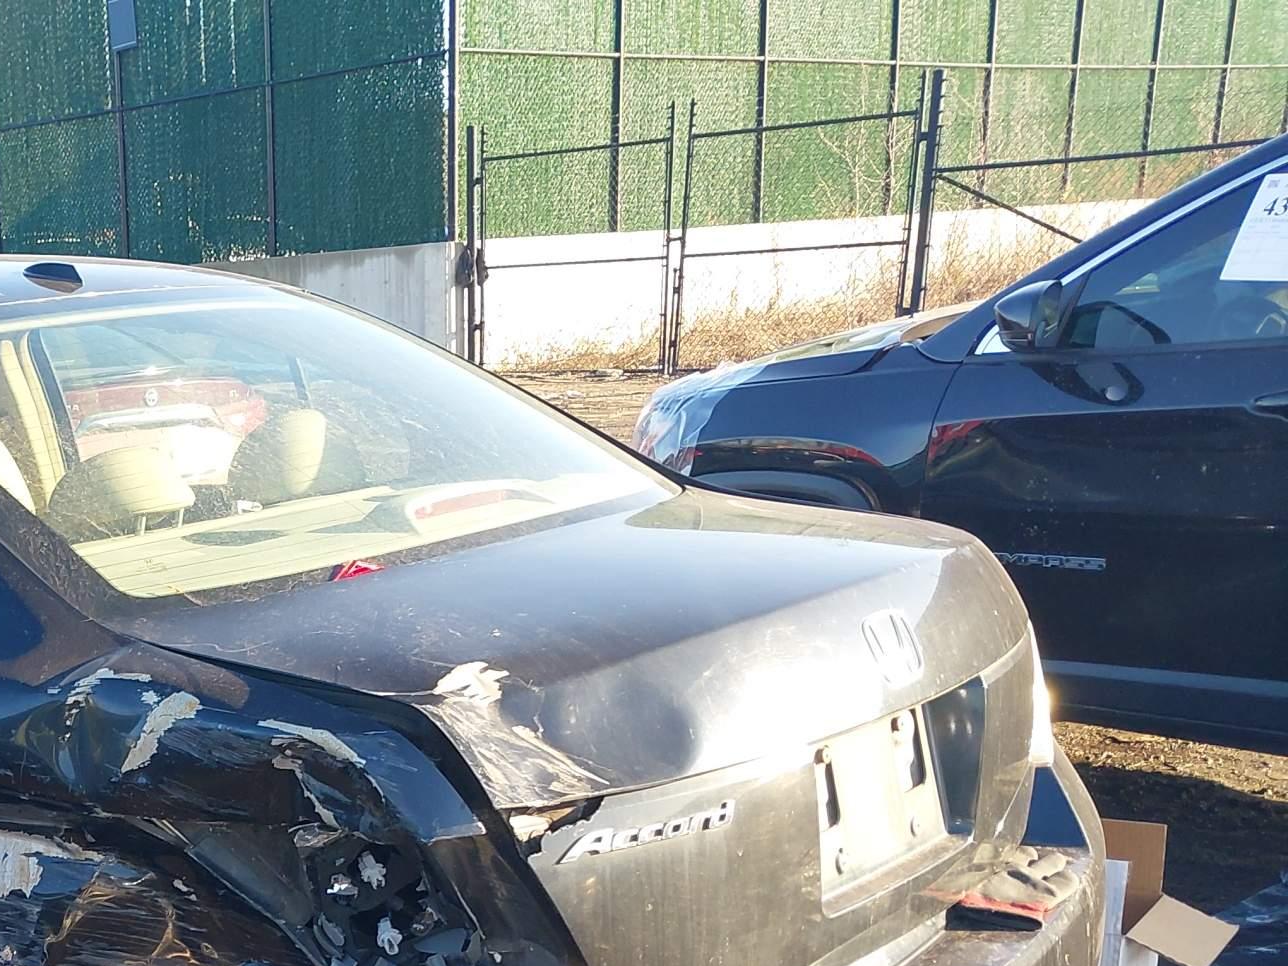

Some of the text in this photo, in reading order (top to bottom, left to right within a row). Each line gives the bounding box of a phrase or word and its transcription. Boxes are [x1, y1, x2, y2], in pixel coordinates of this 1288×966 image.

[1263, 196, 1288, 216] 43
[994, 552, 1107, 570] MPASS
[556, 799, 736, 864] Accord
